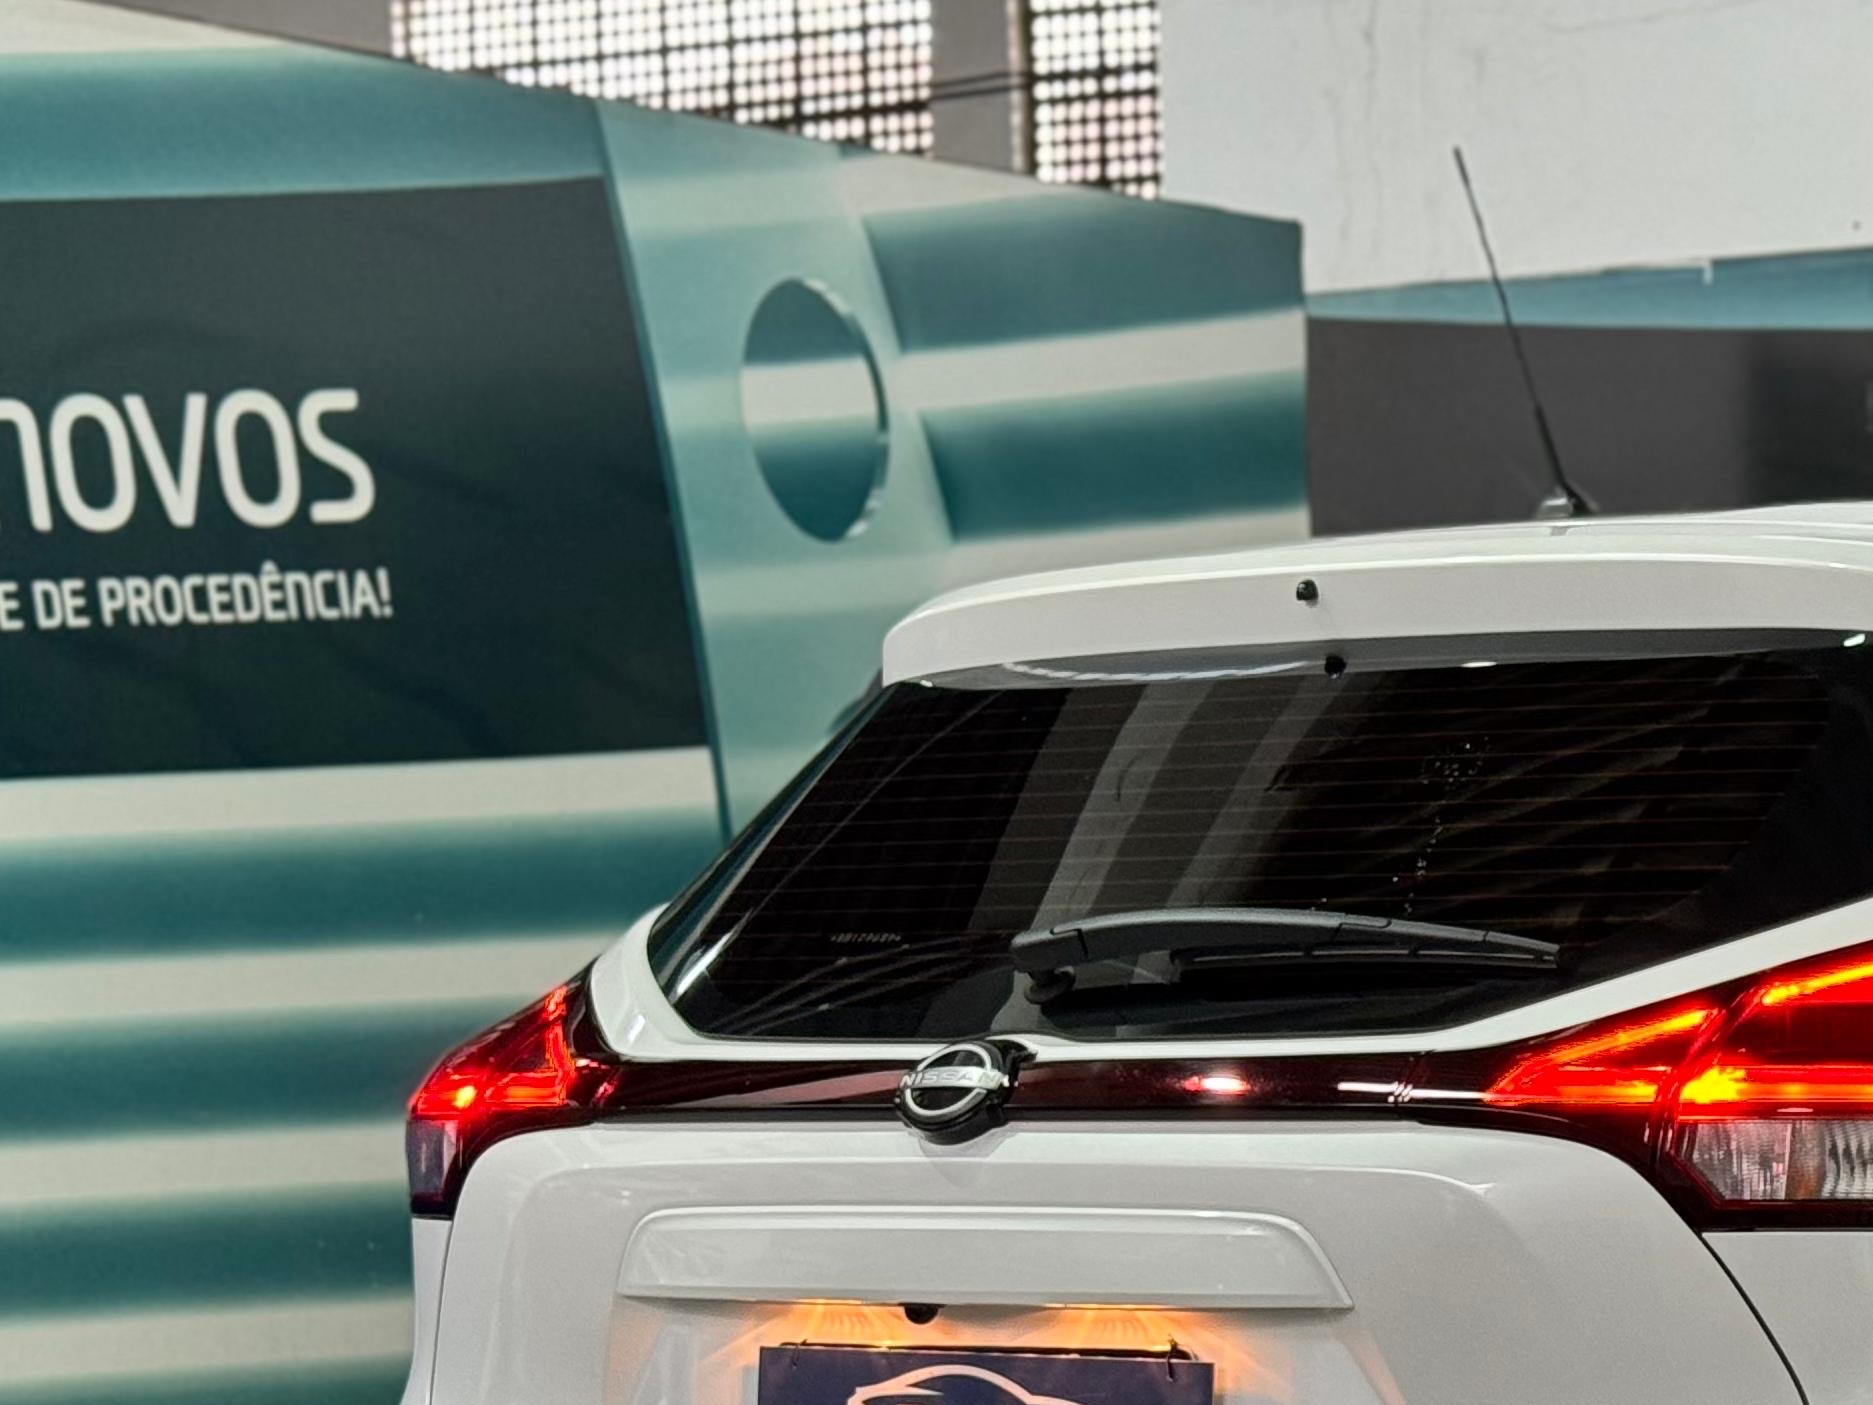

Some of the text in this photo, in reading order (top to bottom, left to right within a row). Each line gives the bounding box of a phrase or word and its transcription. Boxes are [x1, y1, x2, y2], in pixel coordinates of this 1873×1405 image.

[32, 578, 91, 629] DE
[100, 561, 393, 627] PROCEDÊNCIA!
[901, 1069, 1000, 1090] NISSAN
